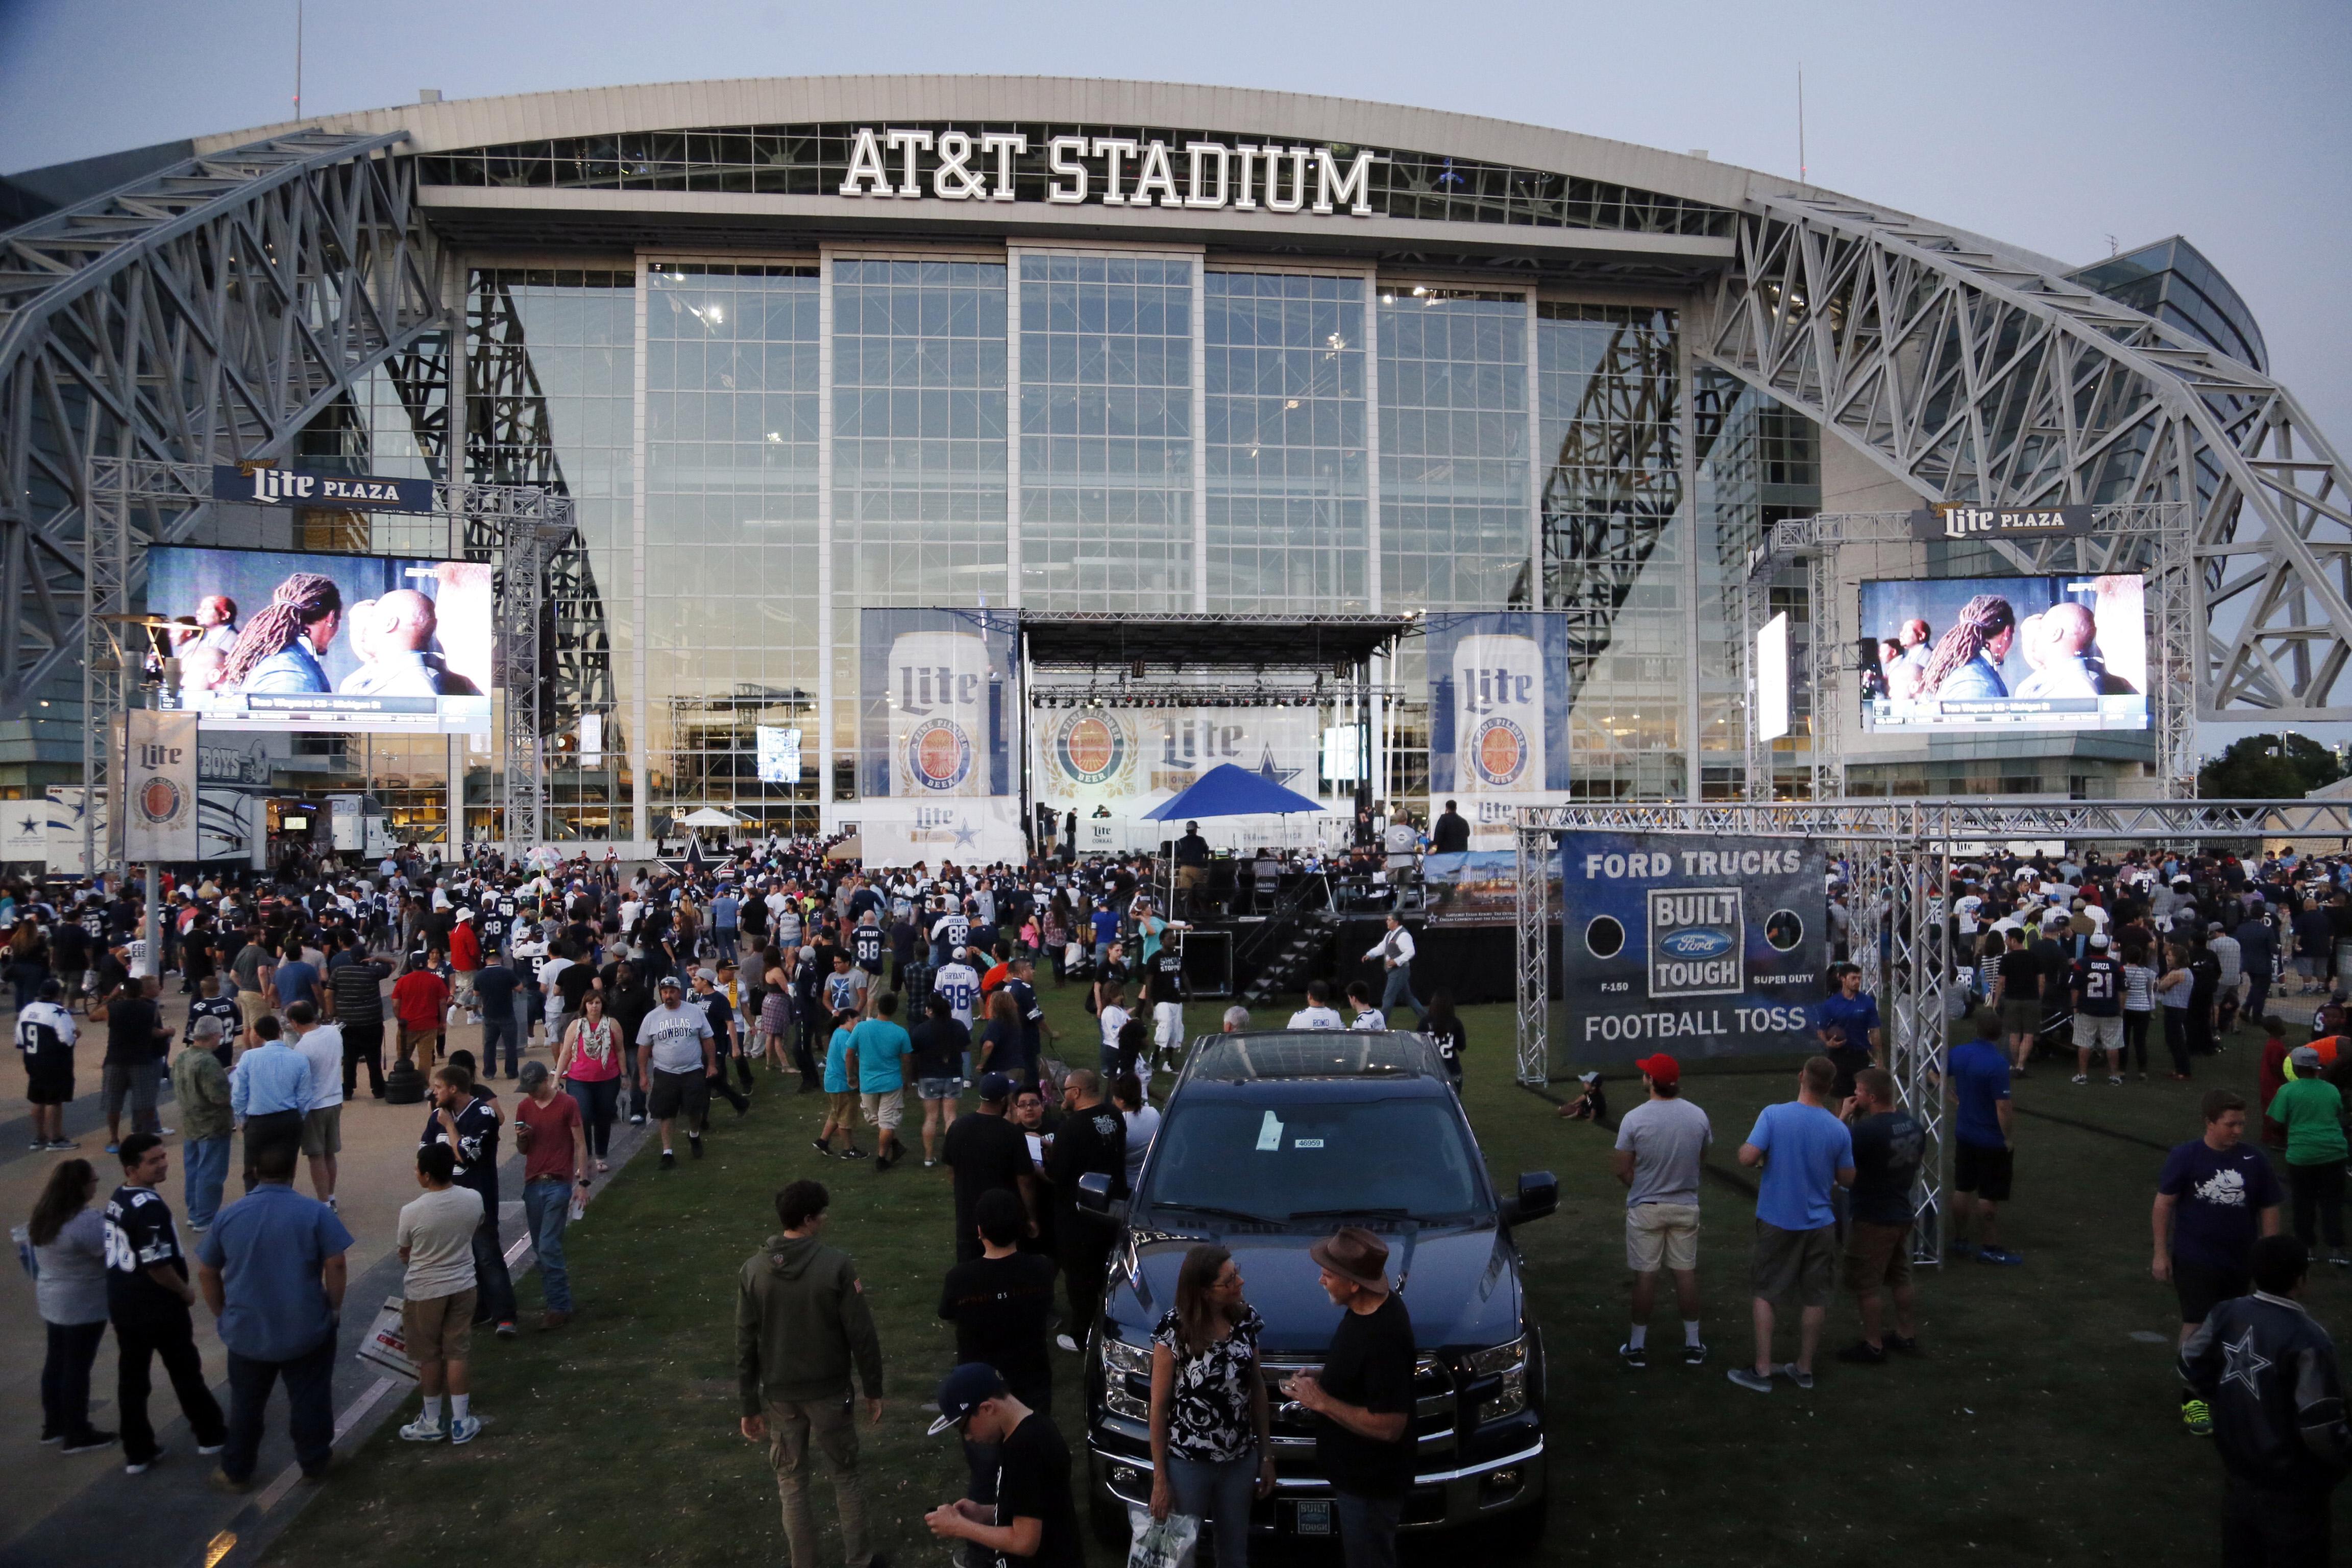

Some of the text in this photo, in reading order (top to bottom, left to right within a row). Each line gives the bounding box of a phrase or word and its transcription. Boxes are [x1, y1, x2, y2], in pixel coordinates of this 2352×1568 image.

[839, 128, 1375, 216] AT&T STADIUM
[252, 468, 314, 503] Lite
[324, 481, 400, 501] PLAZA
[1944, 508, 1994, 538] Lite
[2001, 512, 2065, 528] PLAZA
[899, 666, 978, 716] Lite
[1463, 668, 1533, 714] Lite
[916, 722, 934, 740] FINE
[937, 720, 969, 749] PILSNER
[1063, 710, 1084, 731] FINE
[1088, 709, 1121, 741] PILSNER
[1497, 719, 1525, 747] PILSNER
[1159, 718, 1244, 769] Lite
[140, 743, 182, 771] Lite
[199, 746, 241, 778] BOYS
[927, 778, 955, 788] BEER
[1077, 772, 1107, 782] BEER
[1171, 776, 1196, 784] ONLY
[1488, 775, 1513, 784] BEER
[916, 806, 953, 829] Lite
[1479, 801, 1512, 824] Lite
[1094, 826, 1111, 837] Lite
[1956, 841, 1972, 851] Lite
[1586, 850, 1801, 879] FORD TRUCKS
[1656, 895, 1736, 926] BUILT
[948, 925, 968, 945] 88
[1676, 934, 1715, 952] Ford
[857, 941, 879, 960] 88
[532, 957, 544, 974] 9
[945, 972, 966, 981] BRYANT
[1656, 961, 1736, 987] TOUGH
[2091, 962, 2110, 970] GARZA
[1601, 973, 1815, 992] F-150 SUPER DUTY
[2087, 972, 2113, 998] 21
[942, 984, 970, 1010] 88
[657, 1027, 693, 1041] COWBOYS
[659, 1018, 691, 1031] DALLAS
[1313, 1019, 1330, 1027] ROMO
[1585, 1007, 1806, 1041] FOOTBALL TOSS
[27, 1024, 38, 1054] 9
[1301, 1503, 1326, 1514] BUILT
[1301, 1523, 1328, 1531] TOUGH
